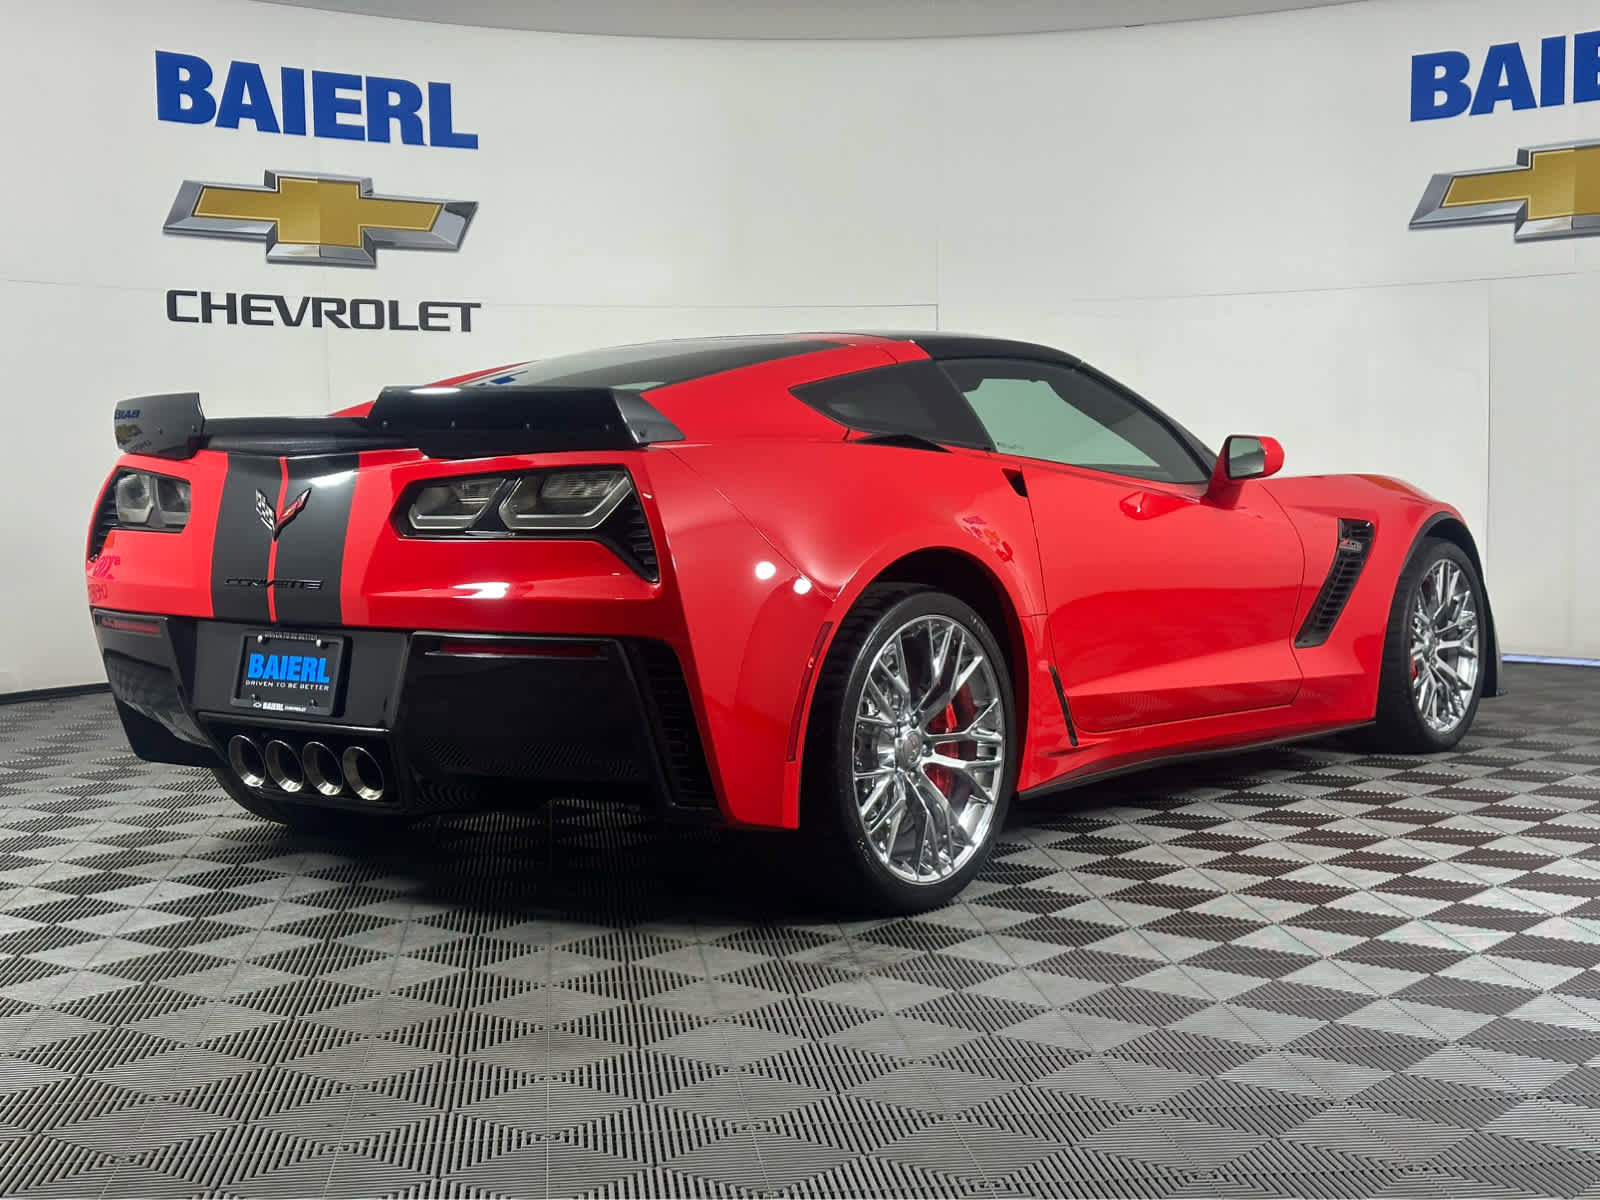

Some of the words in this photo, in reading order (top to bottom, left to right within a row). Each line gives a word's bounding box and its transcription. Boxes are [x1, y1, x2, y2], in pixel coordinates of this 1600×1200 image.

[155, 50, 478, 149] BAIERL
[166, 289, 482, 332] CHEVROLET
[248, 653, 330, 683] BAIERL
[262, 702, 284, 711] BAIERL
